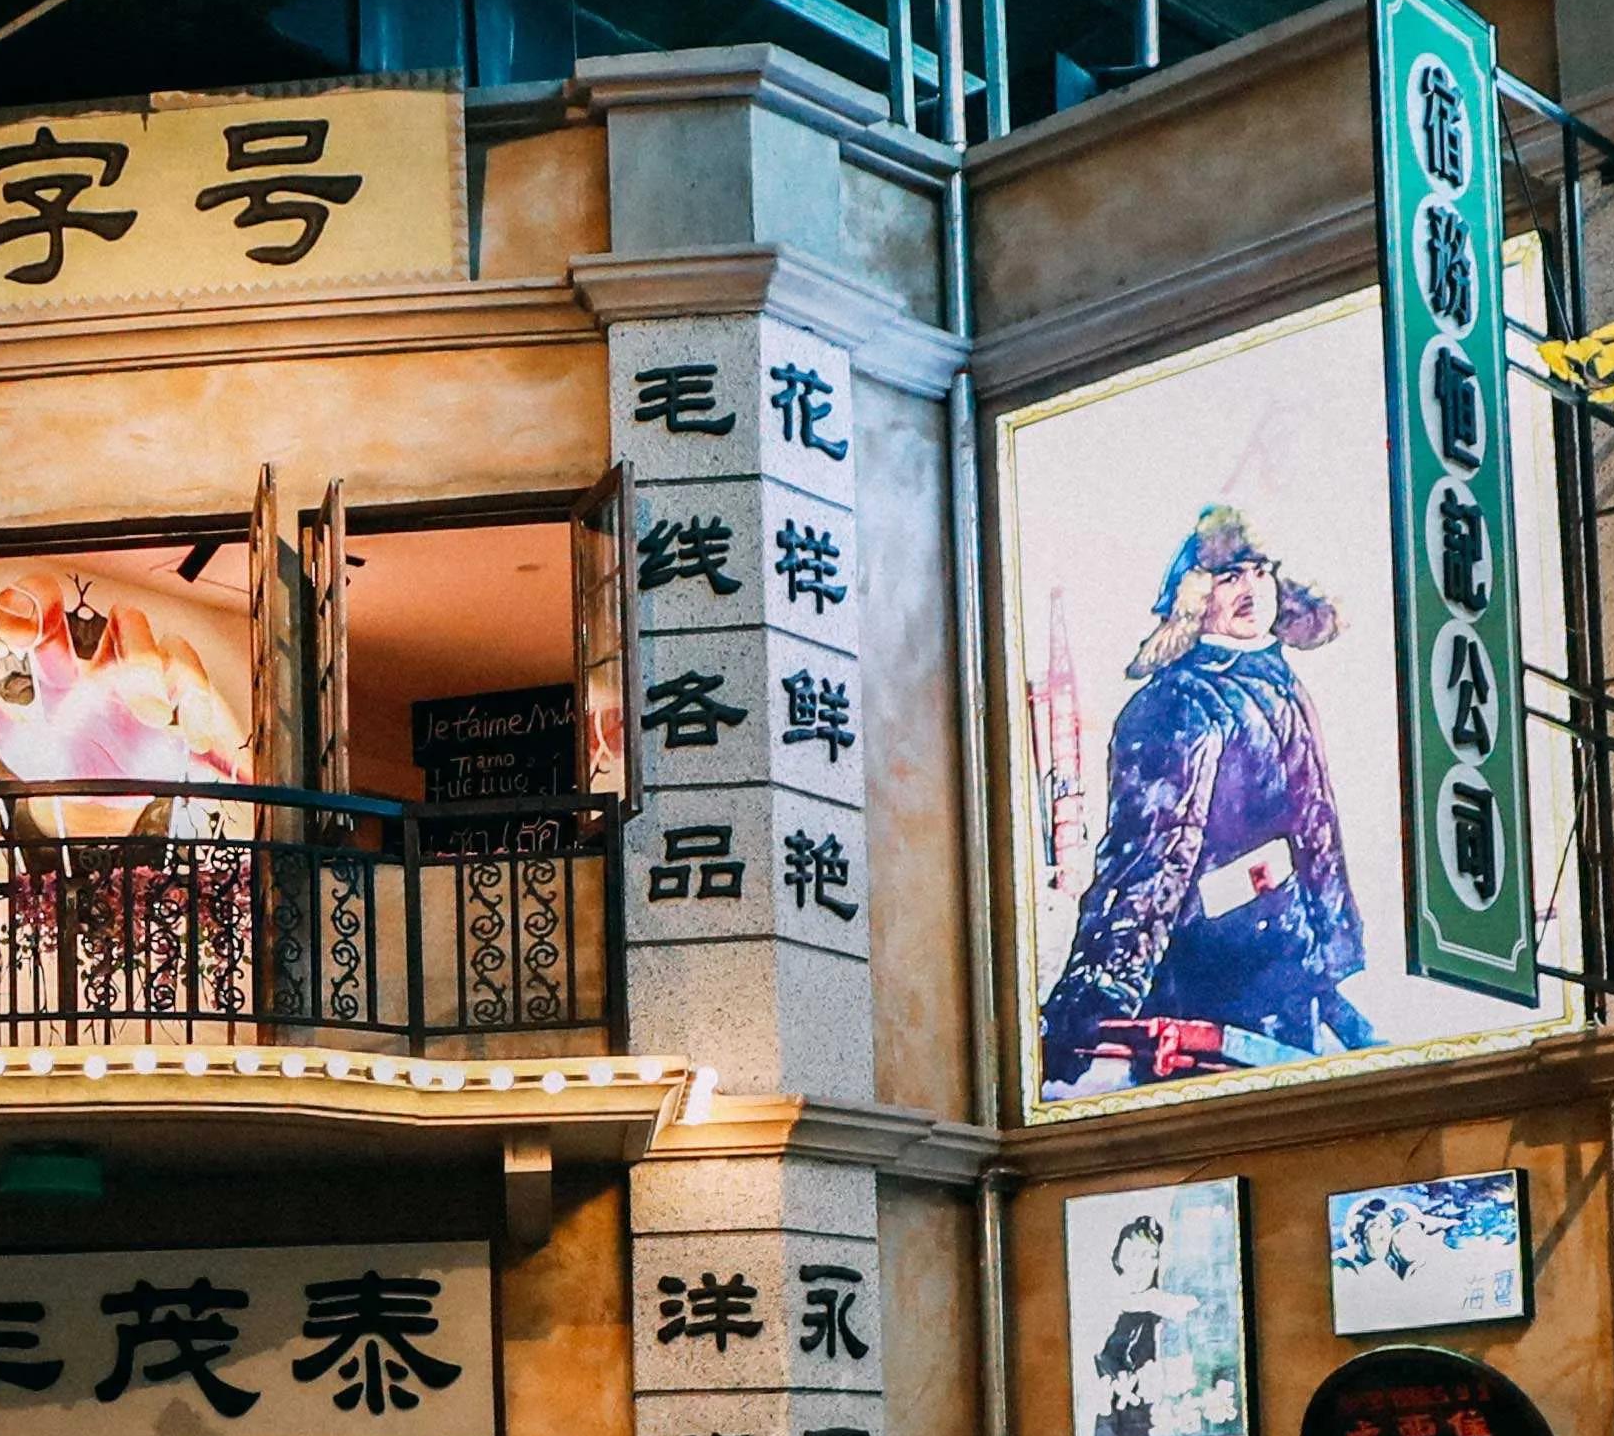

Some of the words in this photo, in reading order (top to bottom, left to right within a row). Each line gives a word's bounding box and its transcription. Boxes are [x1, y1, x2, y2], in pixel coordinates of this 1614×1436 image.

[635, 363, 748, 904] 毛线各品
[771, 363, 859, 921] 花样鲜艳
